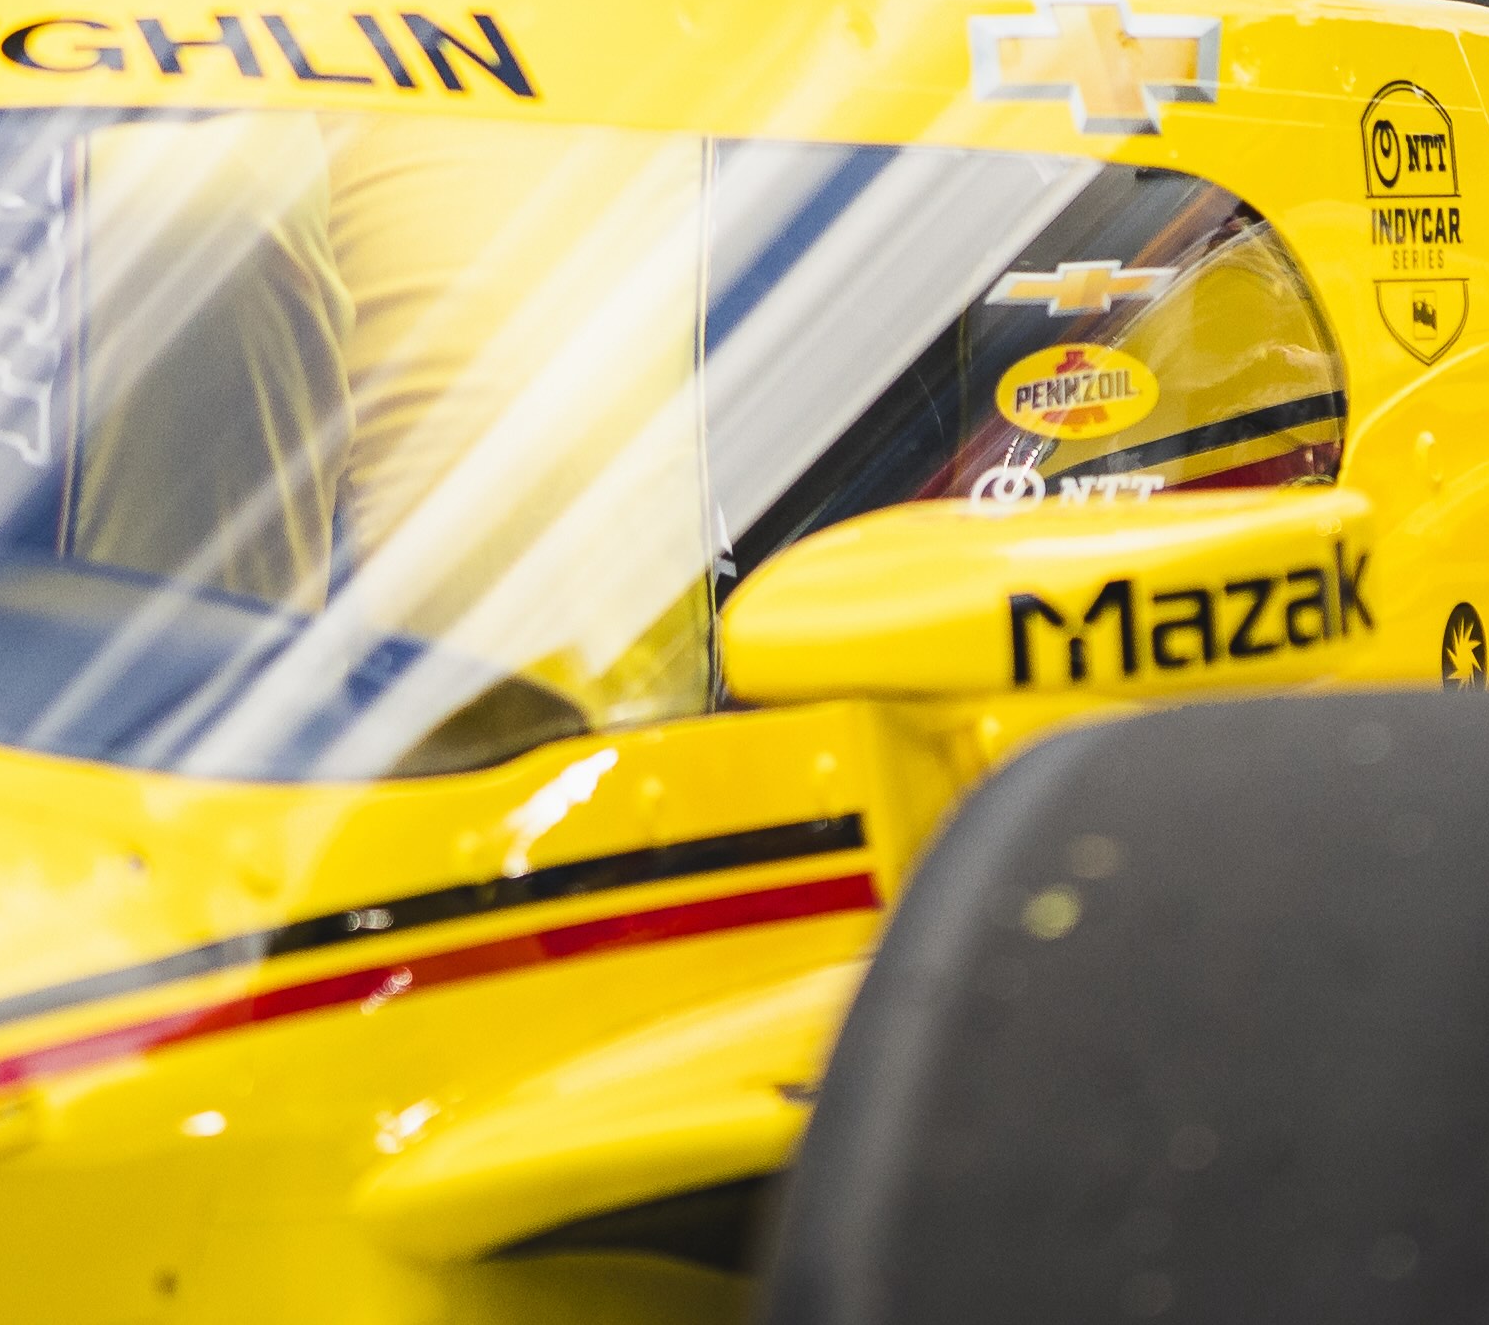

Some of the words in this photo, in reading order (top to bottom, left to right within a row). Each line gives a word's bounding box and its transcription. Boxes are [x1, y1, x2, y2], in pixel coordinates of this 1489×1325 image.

[1405, 133, 1447, 173] NTT
[1371, 207, 1461, 246] INDYCAR
[1393, 249, 1445, 270] SERIES
[1015, 369, 1138, 414] PENNZOIL
[1058, 474, 1166, 506] NTT
[1008, 541, 1378, 689] Mazak
